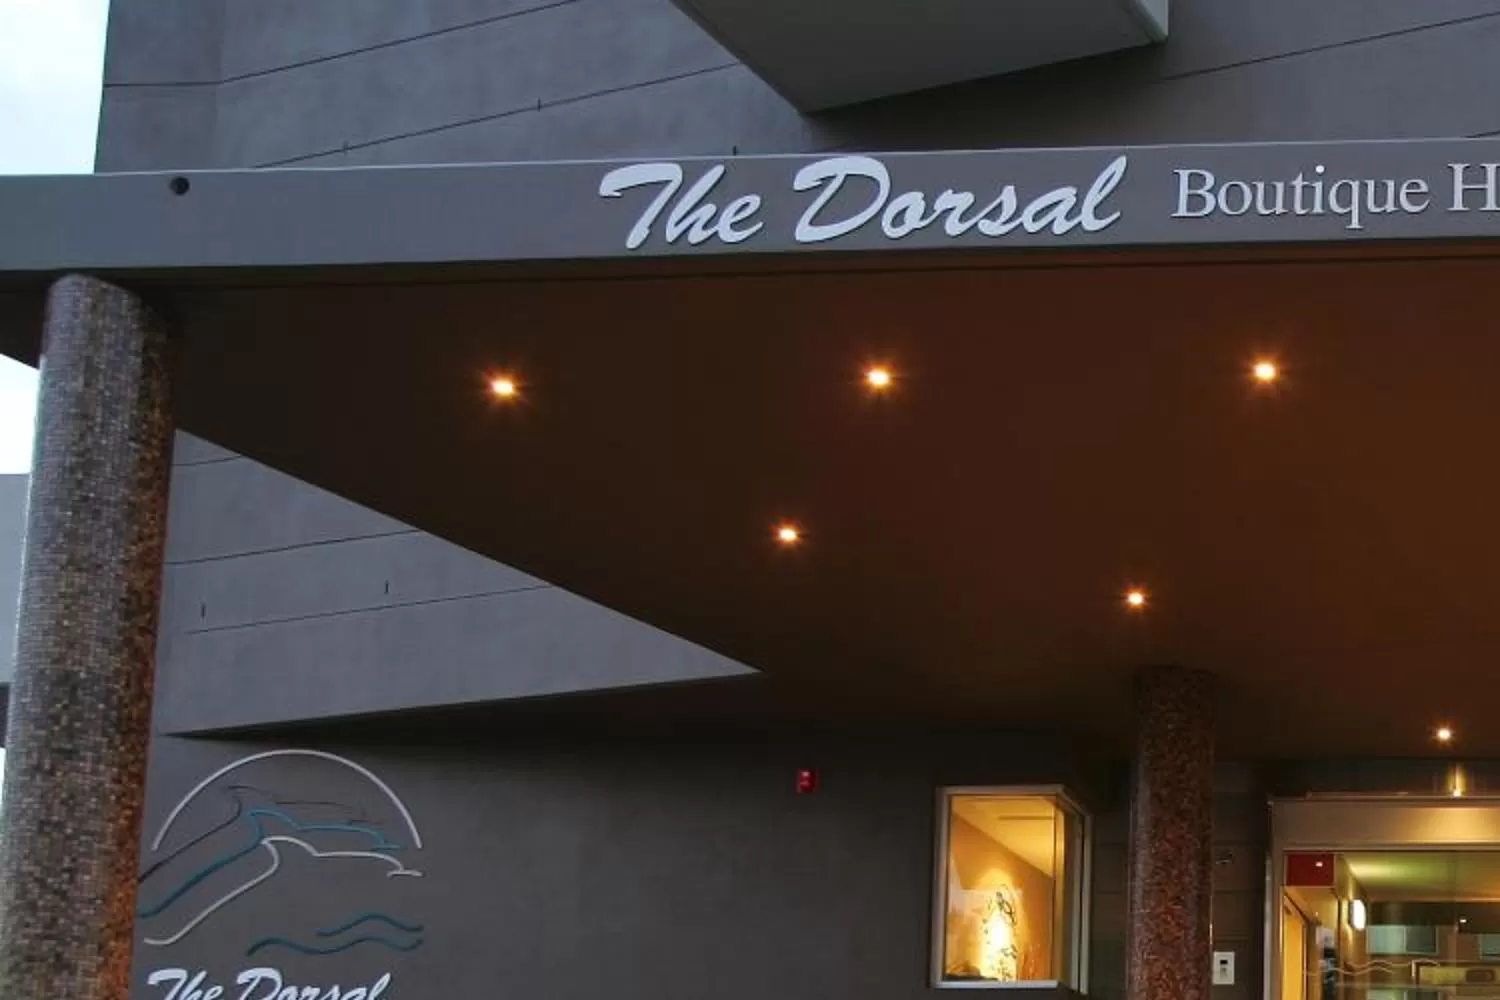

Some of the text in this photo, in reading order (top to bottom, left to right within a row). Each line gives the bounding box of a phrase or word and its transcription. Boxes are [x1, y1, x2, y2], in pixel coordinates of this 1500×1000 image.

[599, 162, 764, 249] The
[794, 155, 1127, 242] Dorsal
[1172, 164, 1430, 230] Boutique
